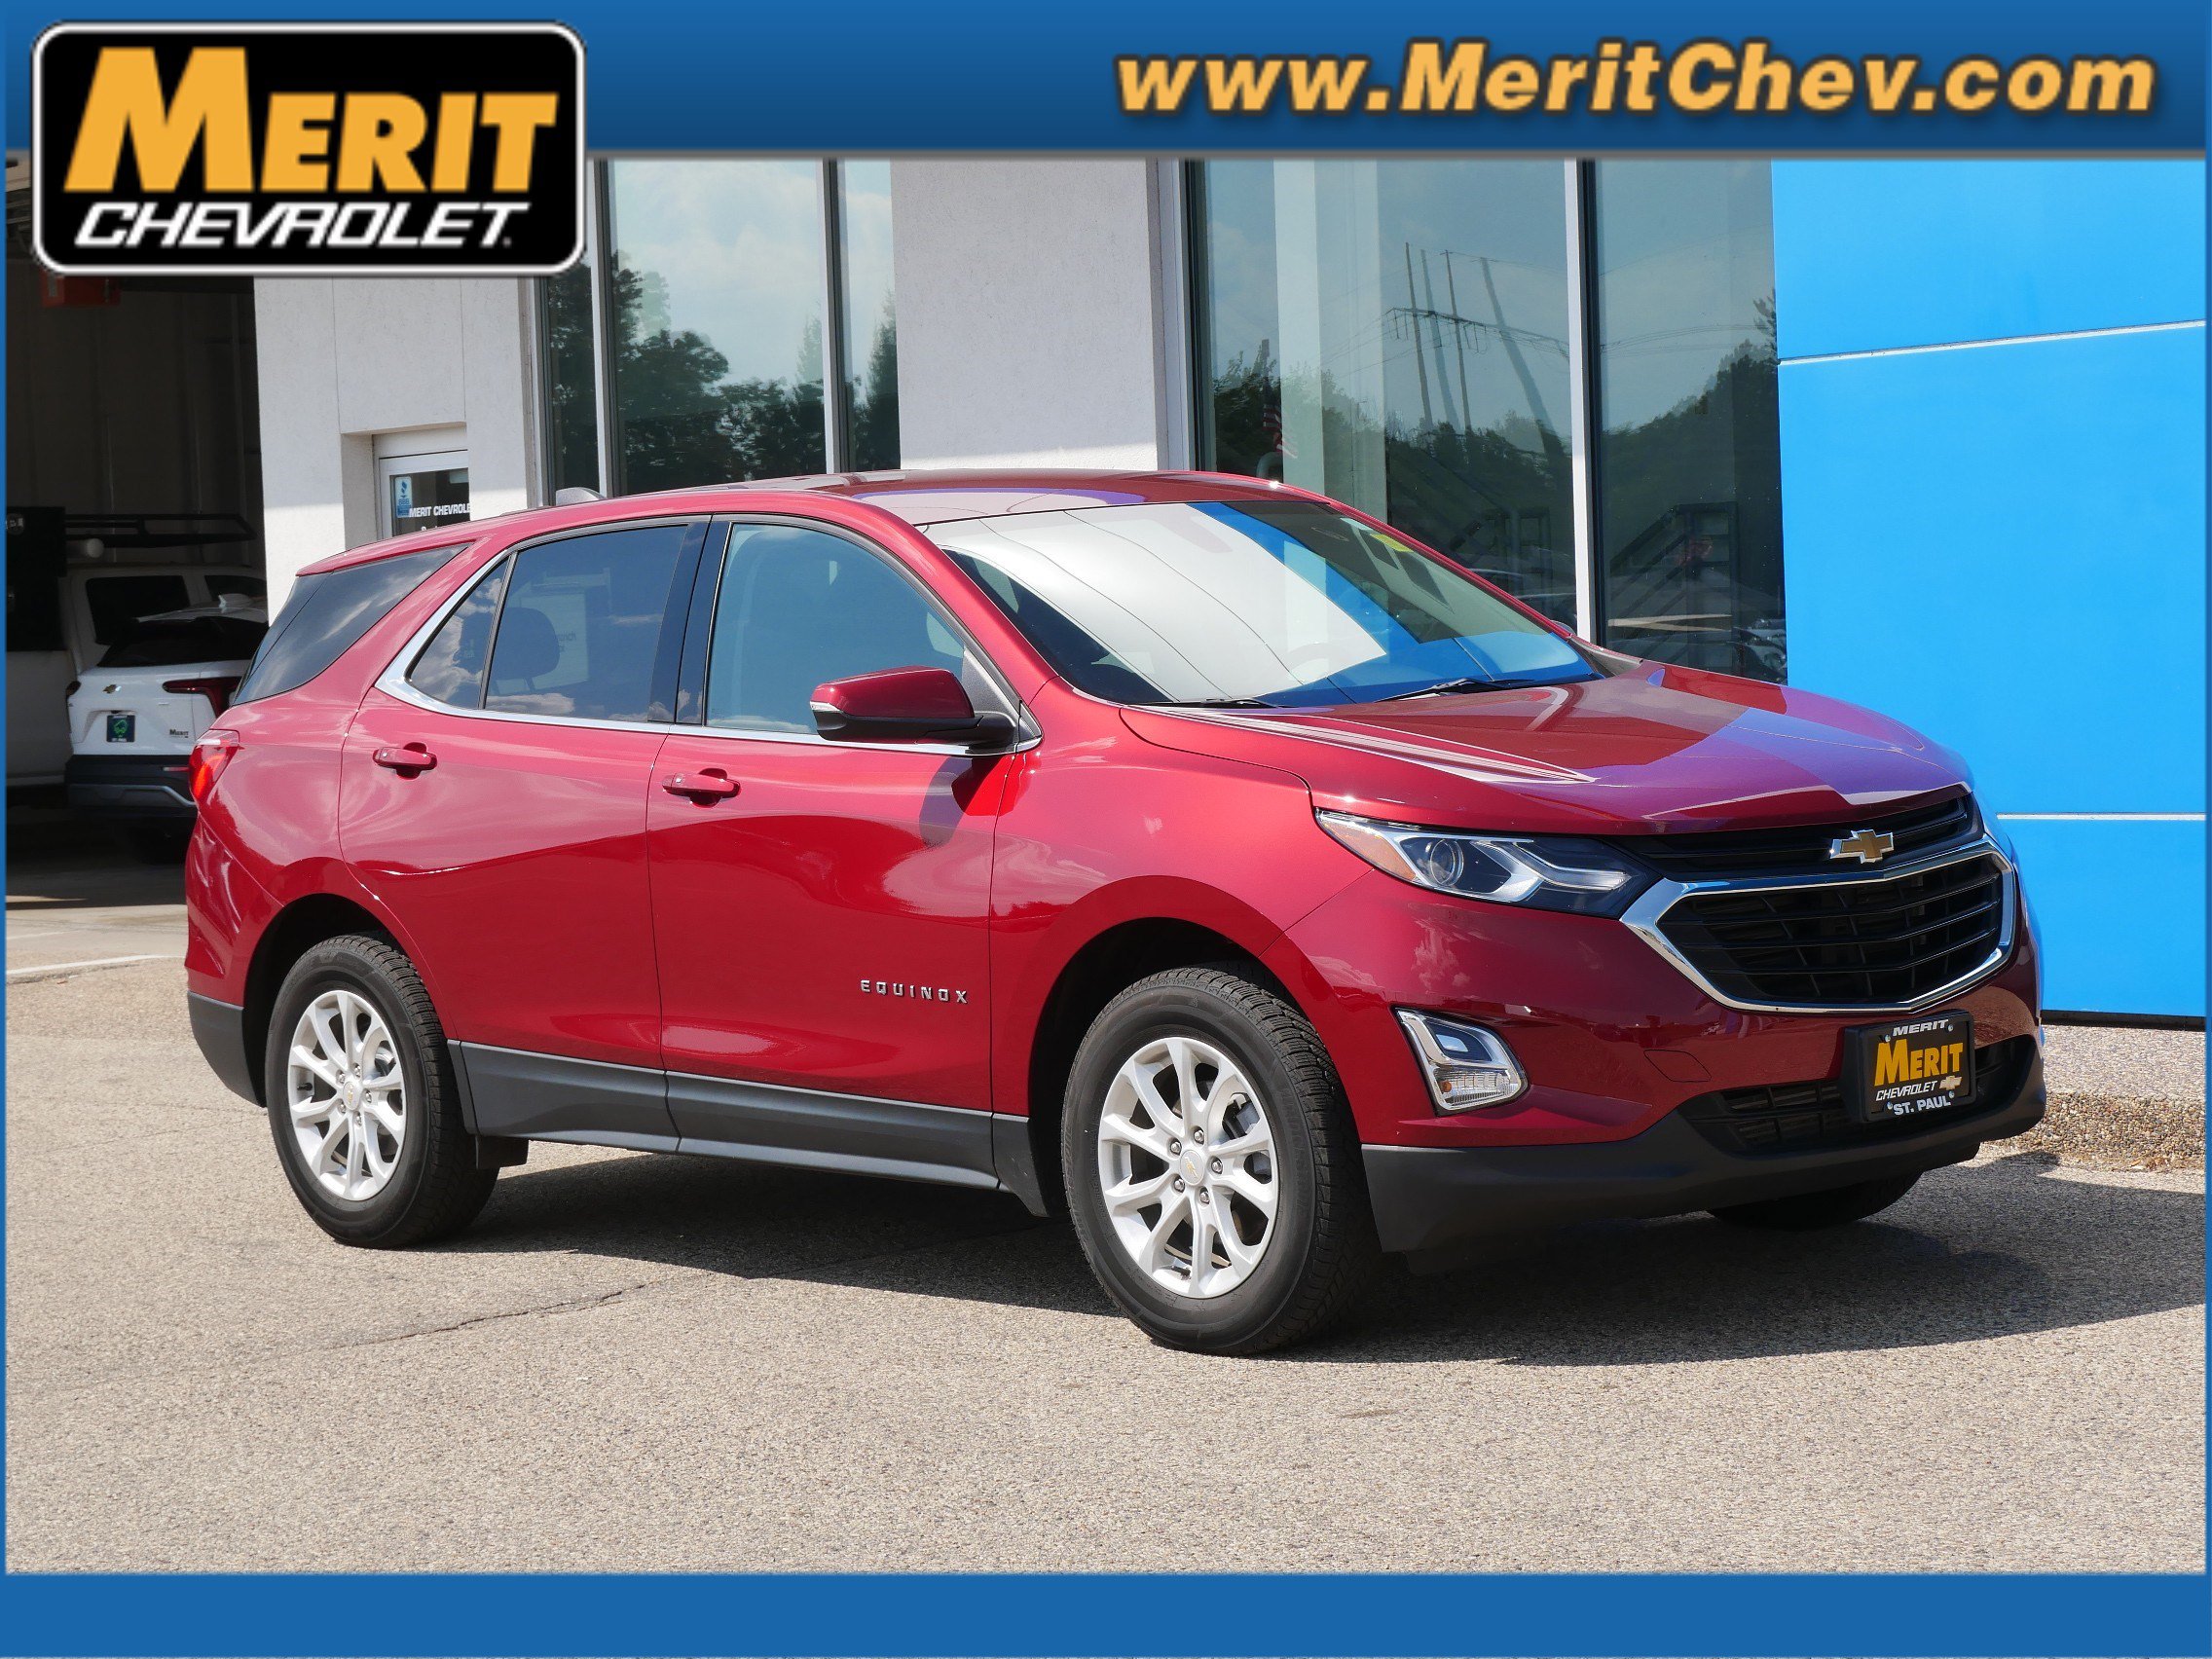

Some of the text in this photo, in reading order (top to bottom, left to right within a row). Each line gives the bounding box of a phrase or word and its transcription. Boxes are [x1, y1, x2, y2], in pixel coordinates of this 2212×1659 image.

[409, 506, 432, 518] MERIT
[860, 979, 968, 1004] EQUINOX
[1893, 1019, 1949, 1037] MERIT
[1874, 1038, 1964, 1087] MERIT
[1875, 1080, 1938, 1101] CHEVROLET
[1917, 1095, 1952, 1112] PAUL
